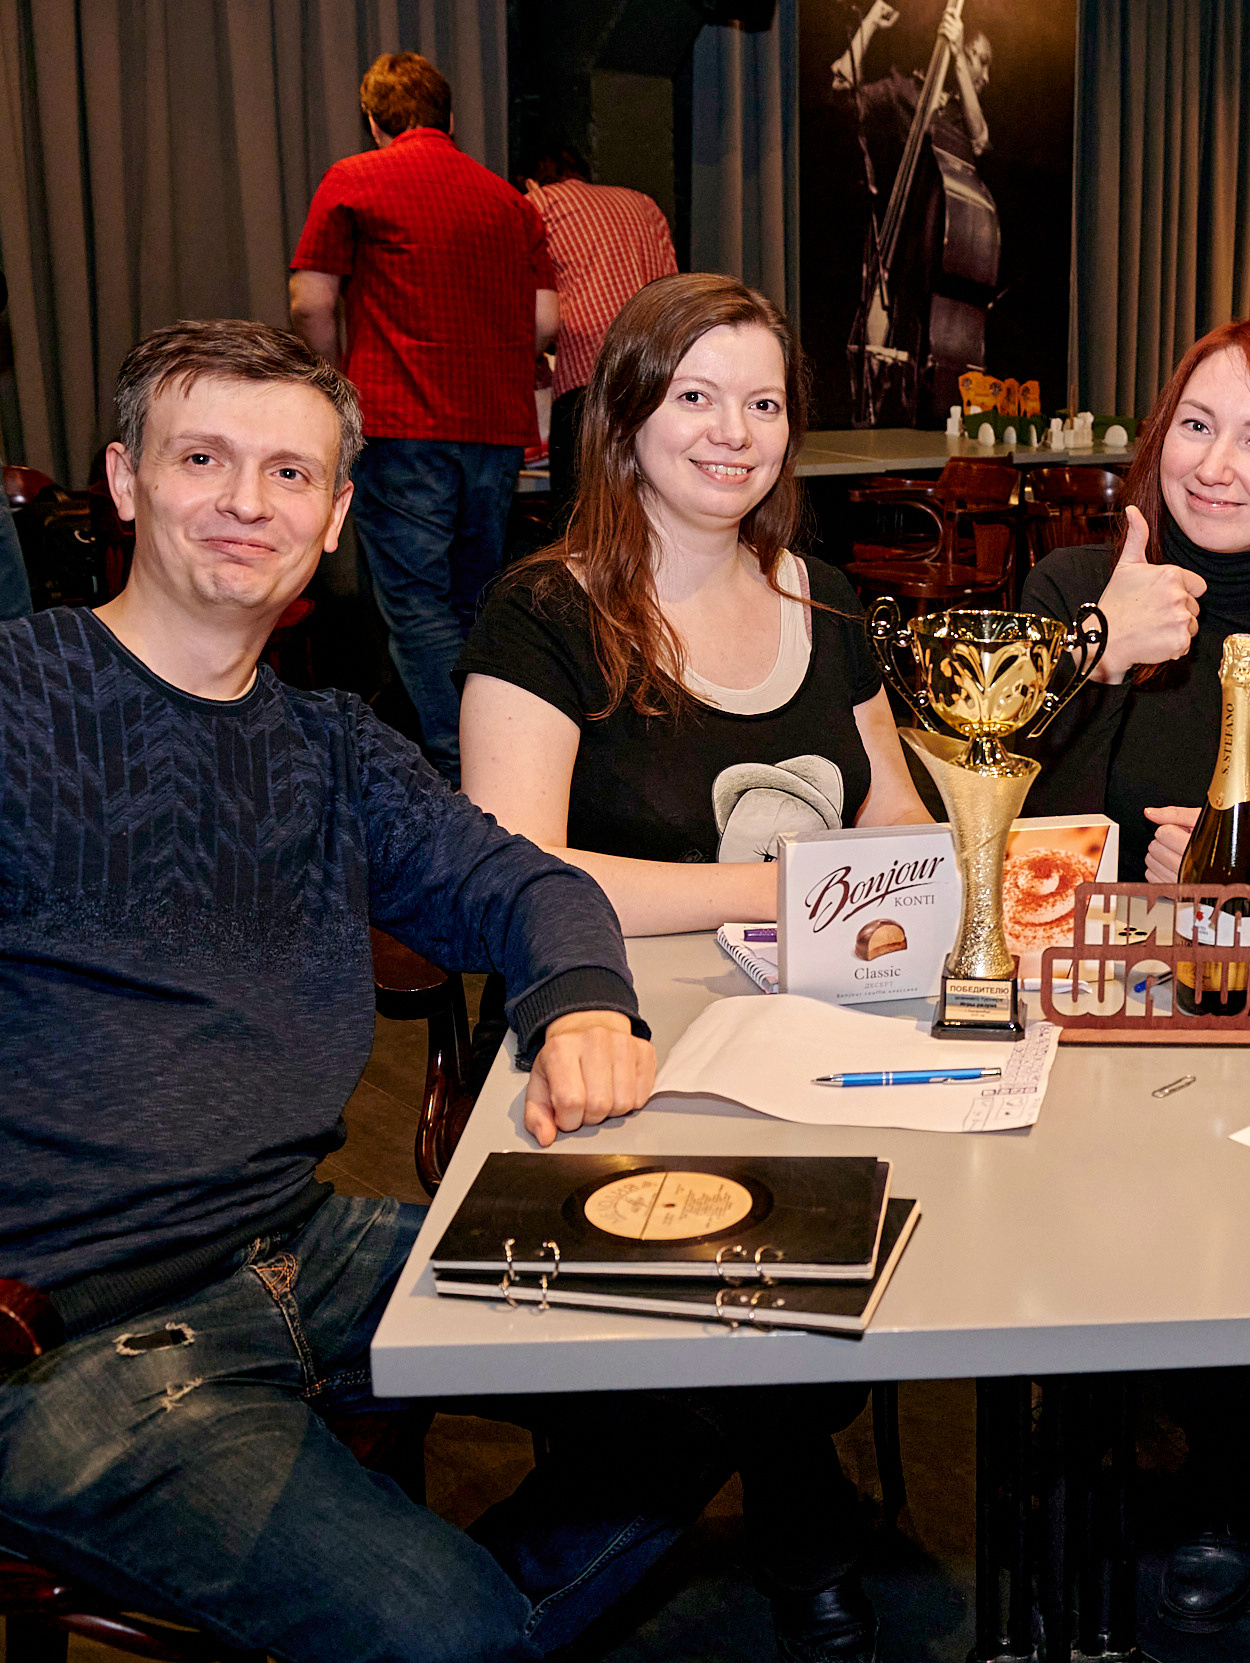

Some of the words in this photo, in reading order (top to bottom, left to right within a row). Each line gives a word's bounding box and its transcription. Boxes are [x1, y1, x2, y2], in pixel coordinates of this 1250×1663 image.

[804, 856, 946, 934] Bonjour
[894, 894, 935, 907] KONTI
[854, 965, 902, 981] Classic
[950, 985, 1009, 995] ПОБЕДИТЕЛЮ
